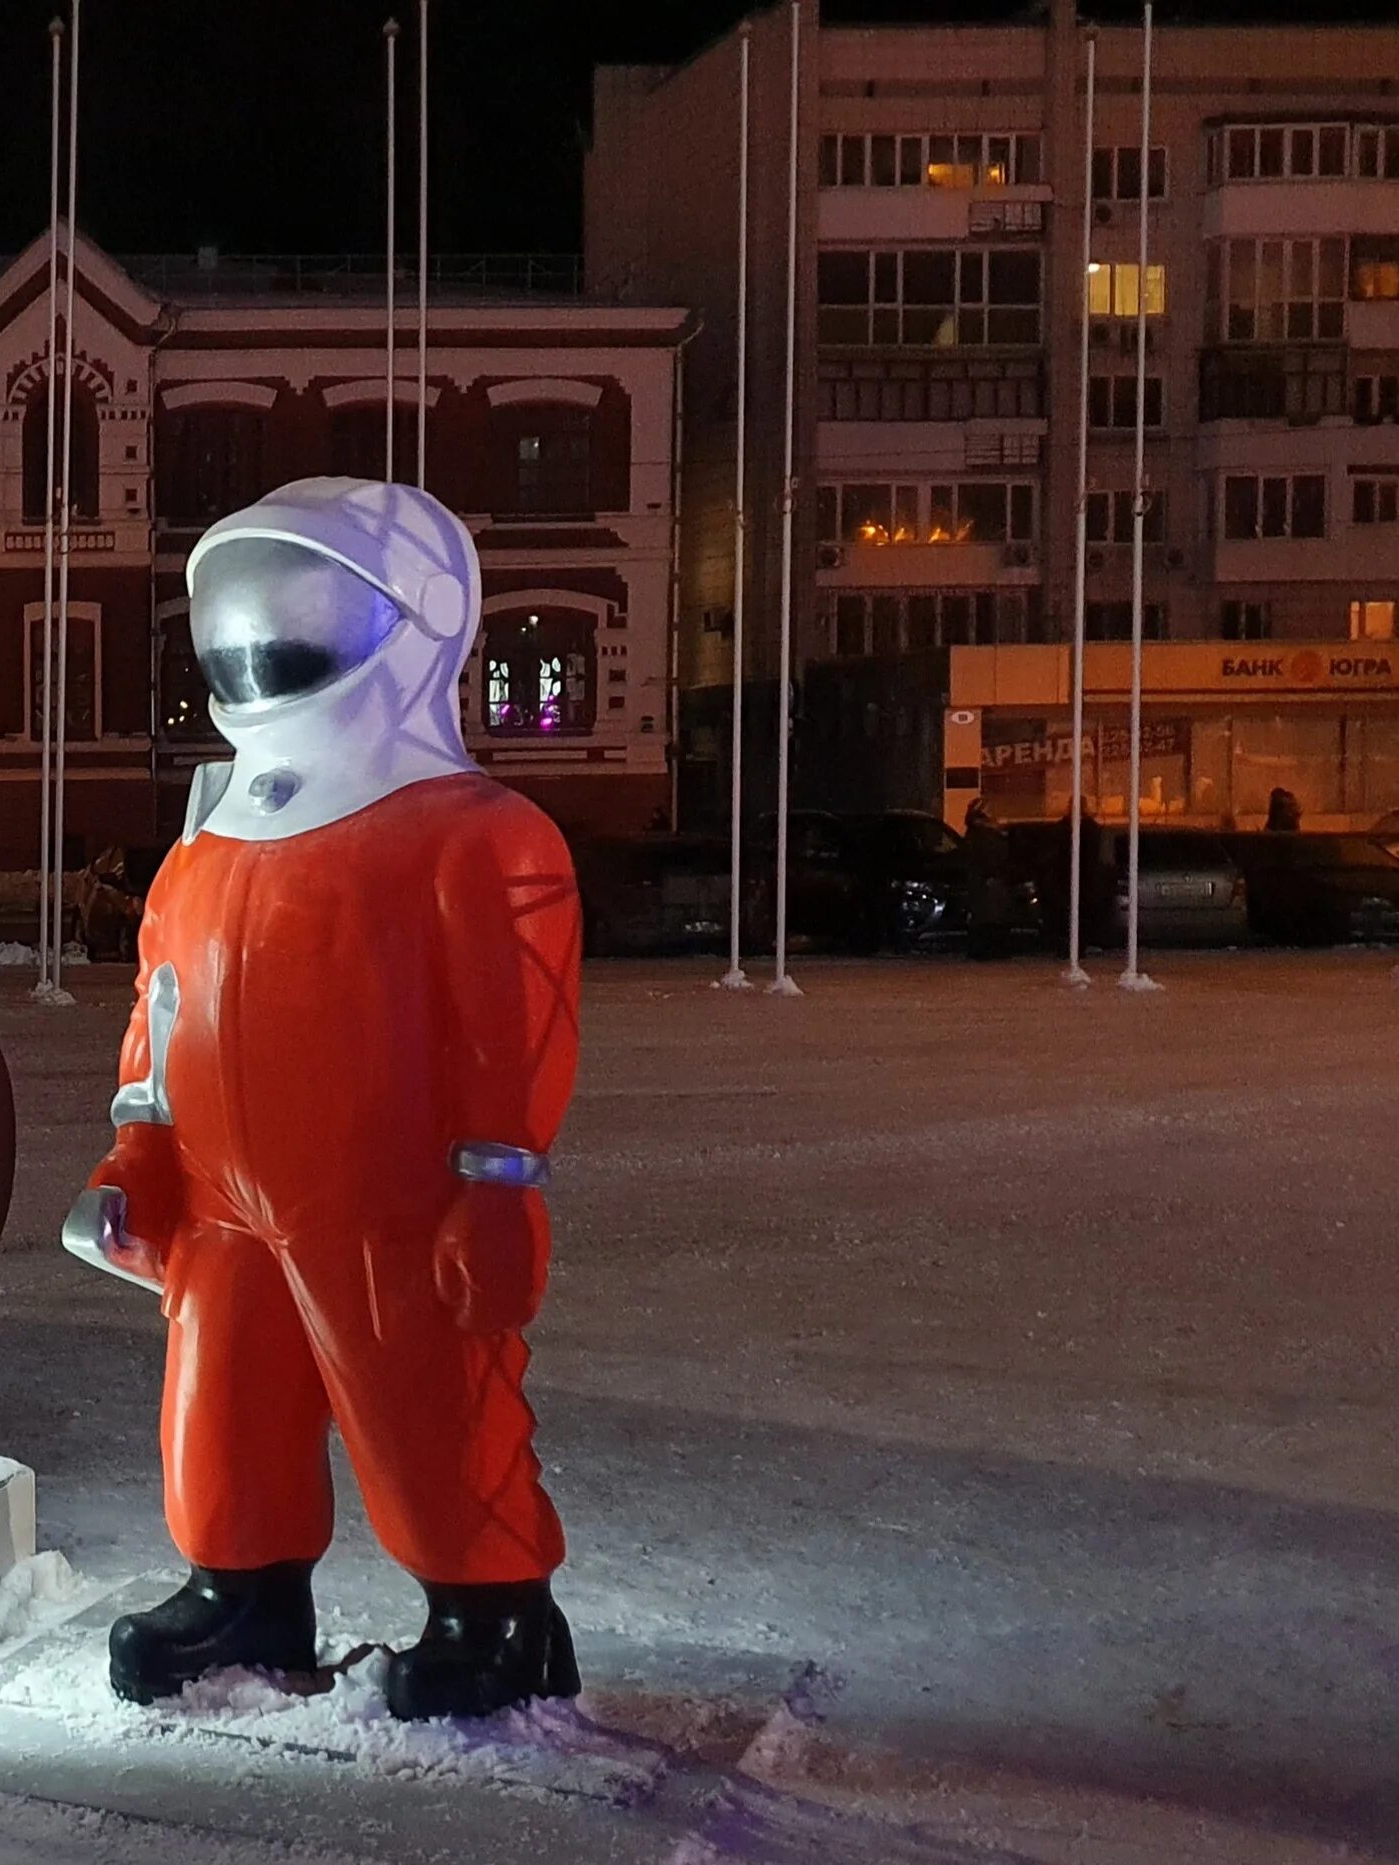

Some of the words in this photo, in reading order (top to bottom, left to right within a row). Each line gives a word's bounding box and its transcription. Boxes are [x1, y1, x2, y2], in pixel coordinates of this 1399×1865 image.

[1221, 658, 1283, 677] БАНК
[1329, 658, 1392, 677] ЮГРА
[981, 735, 1095, 768] АРЕНДА
